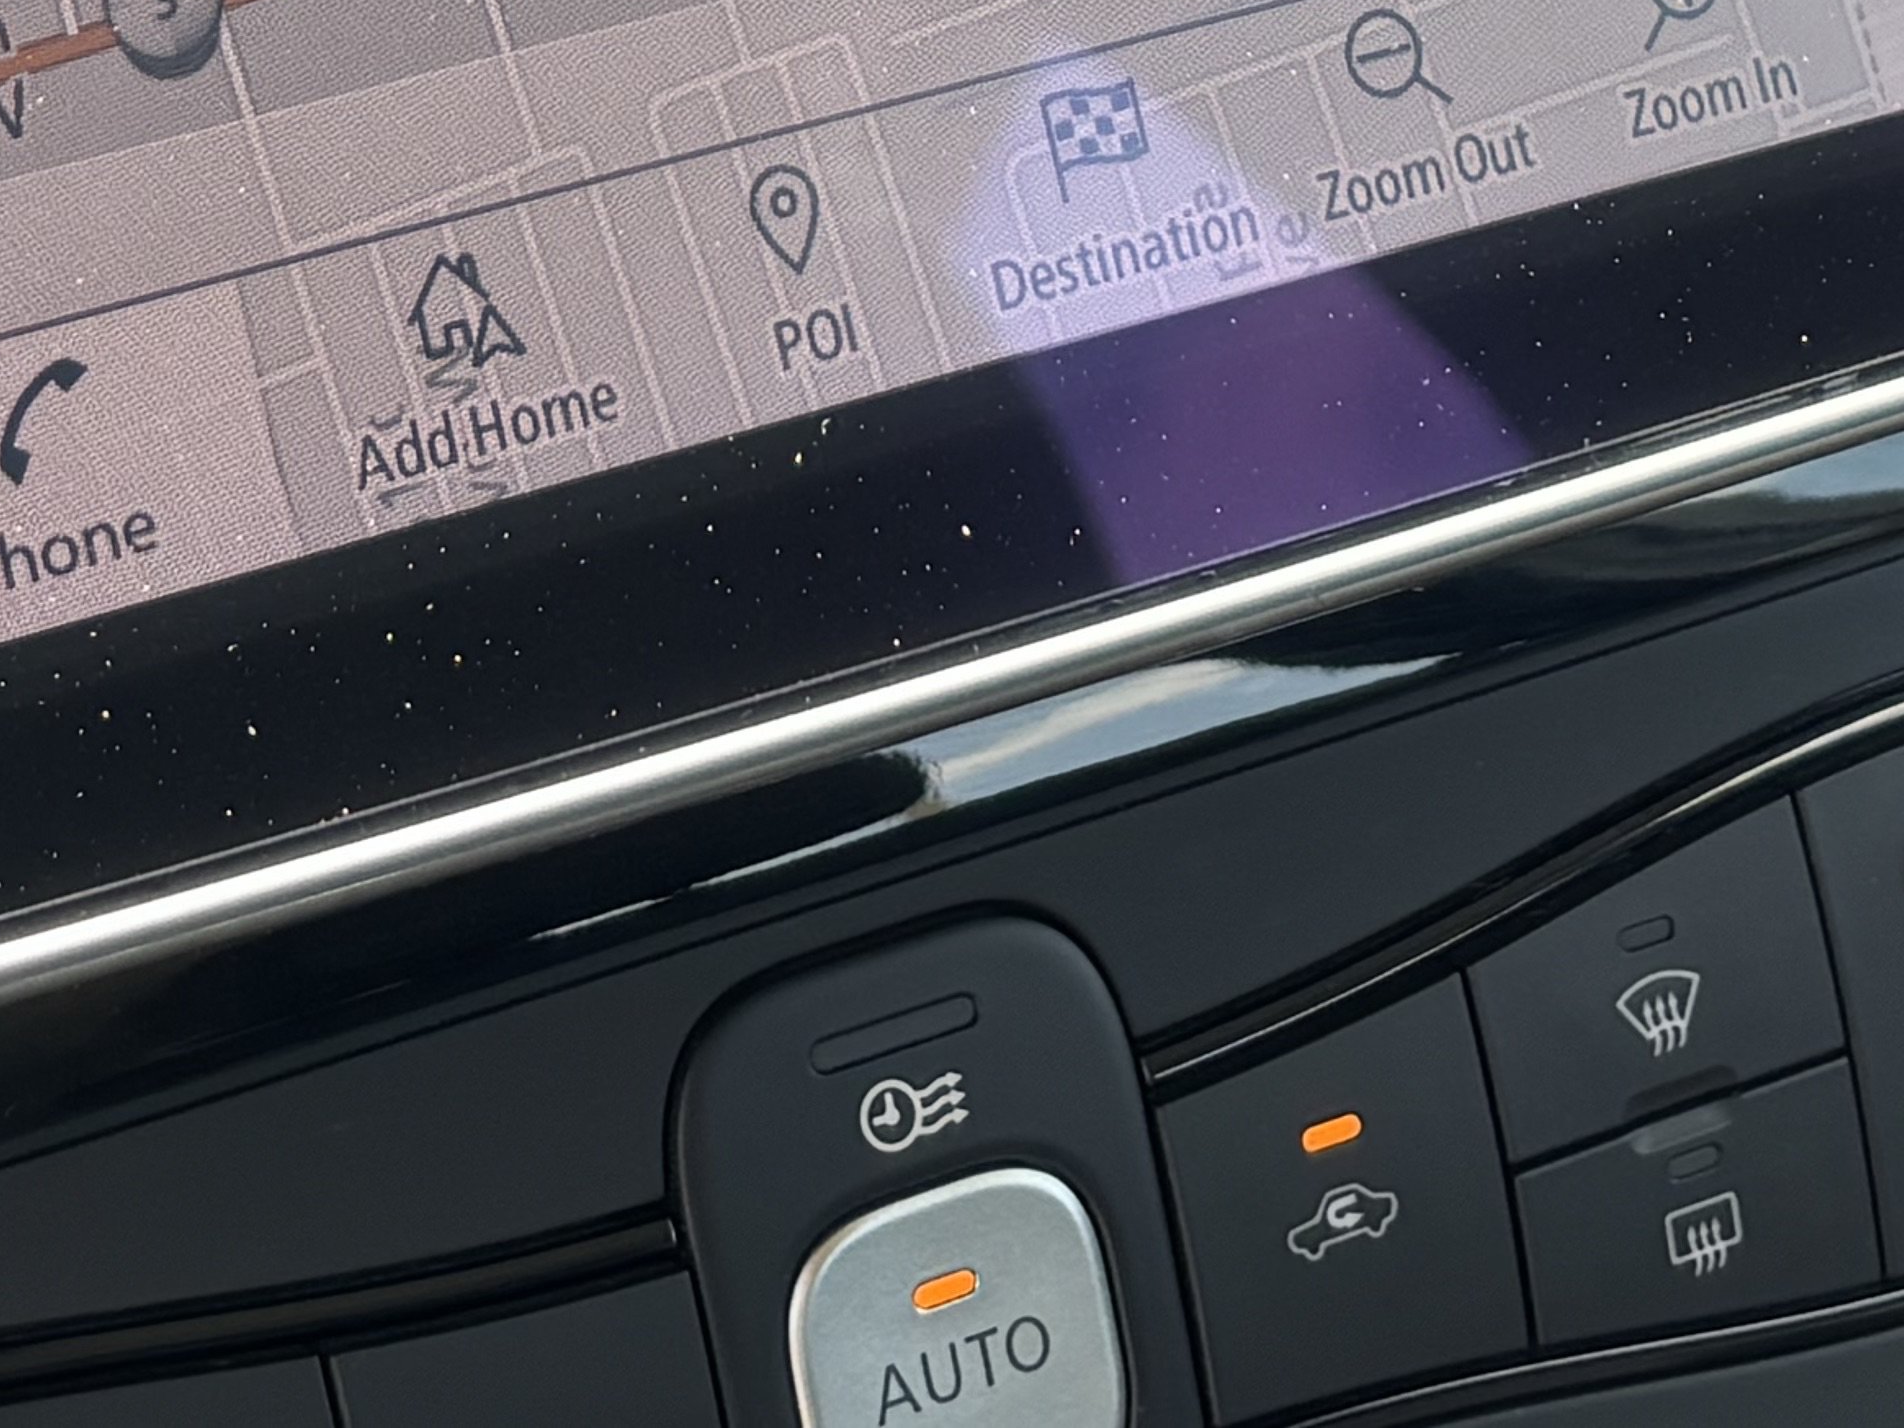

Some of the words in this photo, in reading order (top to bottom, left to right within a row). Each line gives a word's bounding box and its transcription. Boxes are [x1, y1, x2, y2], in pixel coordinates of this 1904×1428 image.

[1623, 70, 1750, 139] Zoom
[1752, 56, 1799, 103] In
[1315, 151, 1447, 224] Zoom
[1452, 123, 1538, 182] Out
[991, 203, 1259, 312] Destination
[773, 302, 862, 372] POI
[357, 409, 460, 491] Add
[469, 381, 619, 458] Home
[877, 1315, 1052, 1428] AUTO
